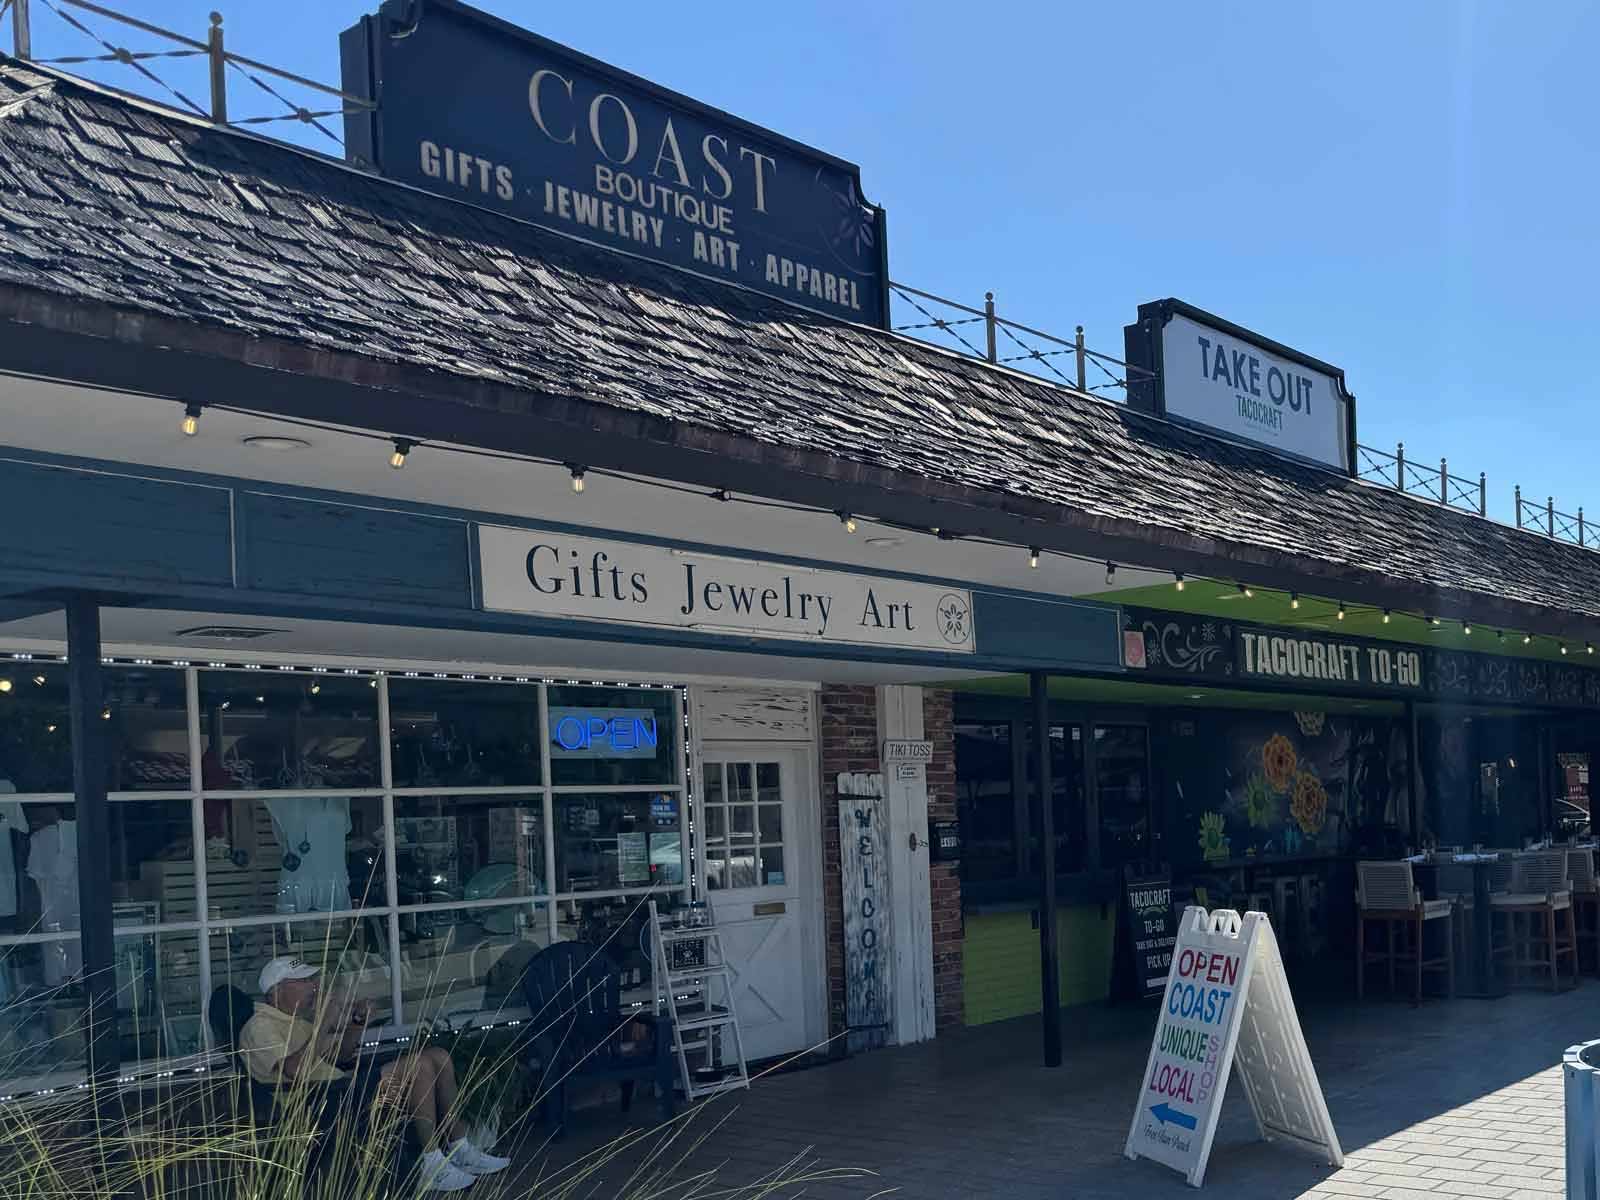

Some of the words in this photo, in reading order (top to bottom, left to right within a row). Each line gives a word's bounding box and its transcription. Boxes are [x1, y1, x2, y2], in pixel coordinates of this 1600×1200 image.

[528, 70, 776, 215] COAST
[595, 165, 735, 235] BOUTIQUE
[420, 141, 514, 200] GIFTS
[544, 181, 664, 248] JEWELRY
[693, 231, 740, 273] ART
[764, 254, 860, 310] APPAREL
[1198, 336, 1262, 397] TAKE
[1267, 366, 1312, 415] OUT
[1236, 395, 1283, 431] TACOCRAFT
[526, 544, 648, 604] Gifts
[681, 564, 832, 636] Jewelry
[859, 588, 916, 632] Art
[1241, 633, 1360, 681] TACOCRAFT
[1367, 647, 1421, 687] TO-GO
[555, 716, 658, 752] OPEN
[889, 743, 906, 756] TIKI
[909, 744, 930, 757] TOSS
[1130, 889, 1171, 909] TACOCRAFT
[1147, 955, 1162, 969] PICK
[1162, 953, 1171, 967] UP
[1179, 949, 1240, 984] OPEN
[1168, 982, 1231, 1025] COAST
[1159, 1023, 1209, 1063] UNIQUE
[1150, 1061, 1195, 1104] LOCAL
